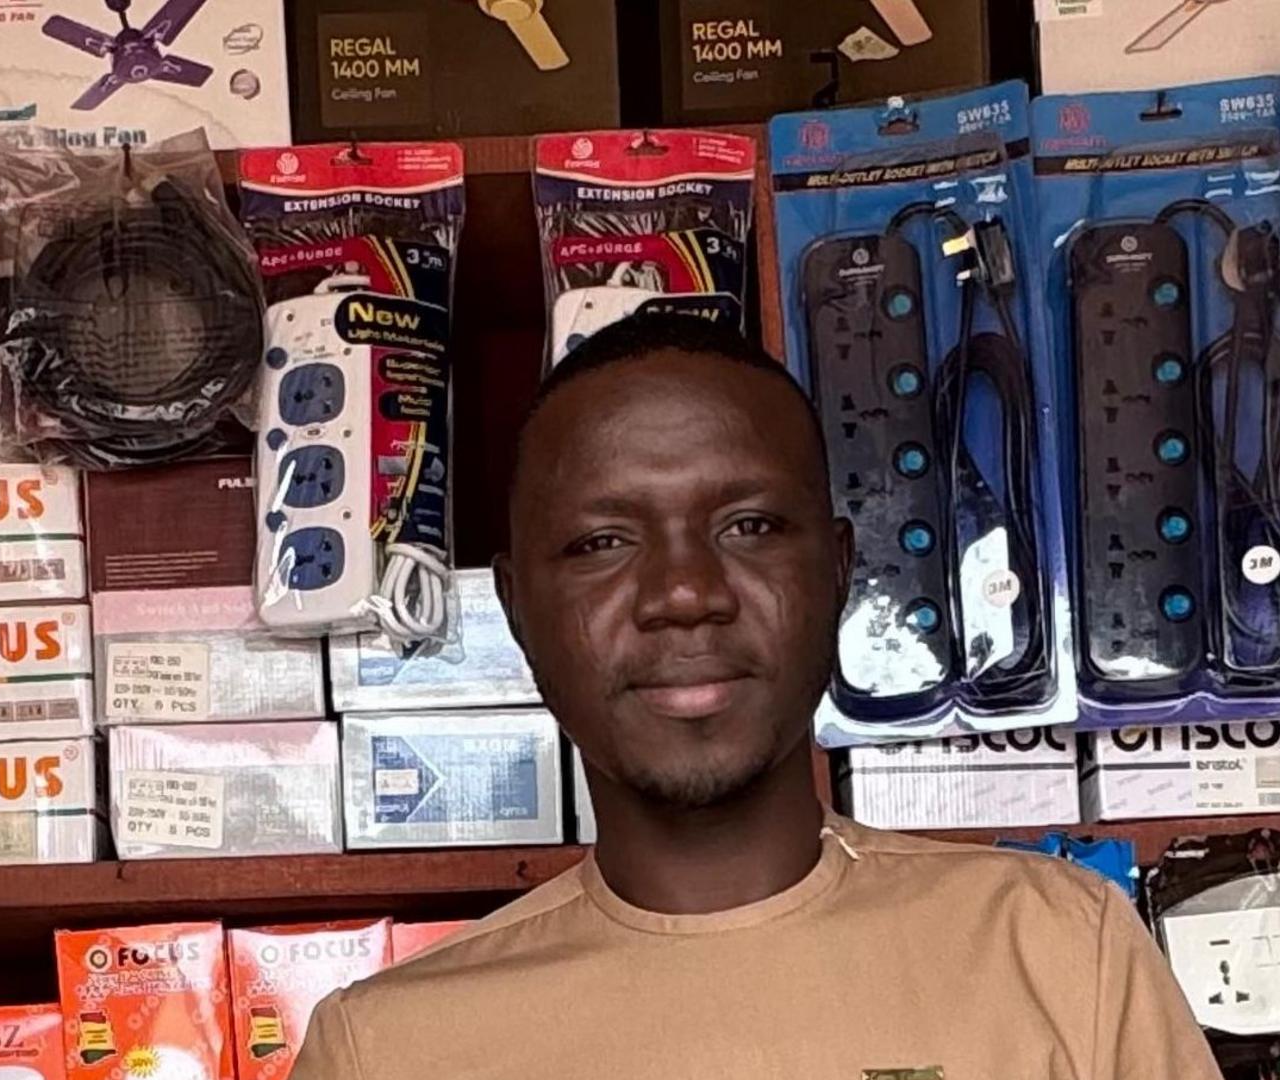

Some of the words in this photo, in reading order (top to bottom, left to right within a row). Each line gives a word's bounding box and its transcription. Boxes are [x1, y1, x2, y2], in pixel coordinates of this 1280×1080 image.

[692, 19, 760, 42] REGAL
[330, 37, 396, 58] REGAL
[692, 43, 743, 64] 1400
[747, 38, 783, 60] MM
[330, 60, 380, 81] 1400
[385, 57, 420, 78] MM
[736, 67, 759, 82] Fan
[375, 86, 397, 100] Fan
[103, 126, 148, 147] Fan
[365, 191, 421, 210] SOCKET
[576, 186, 656, 201] EXTENSION
[658, 181, 714, 199] SOCKET
[347, 301, 421, 331] New
[1250, 556, 1274, 571] 3M
[117, 939, 201, 967] FOCUS
